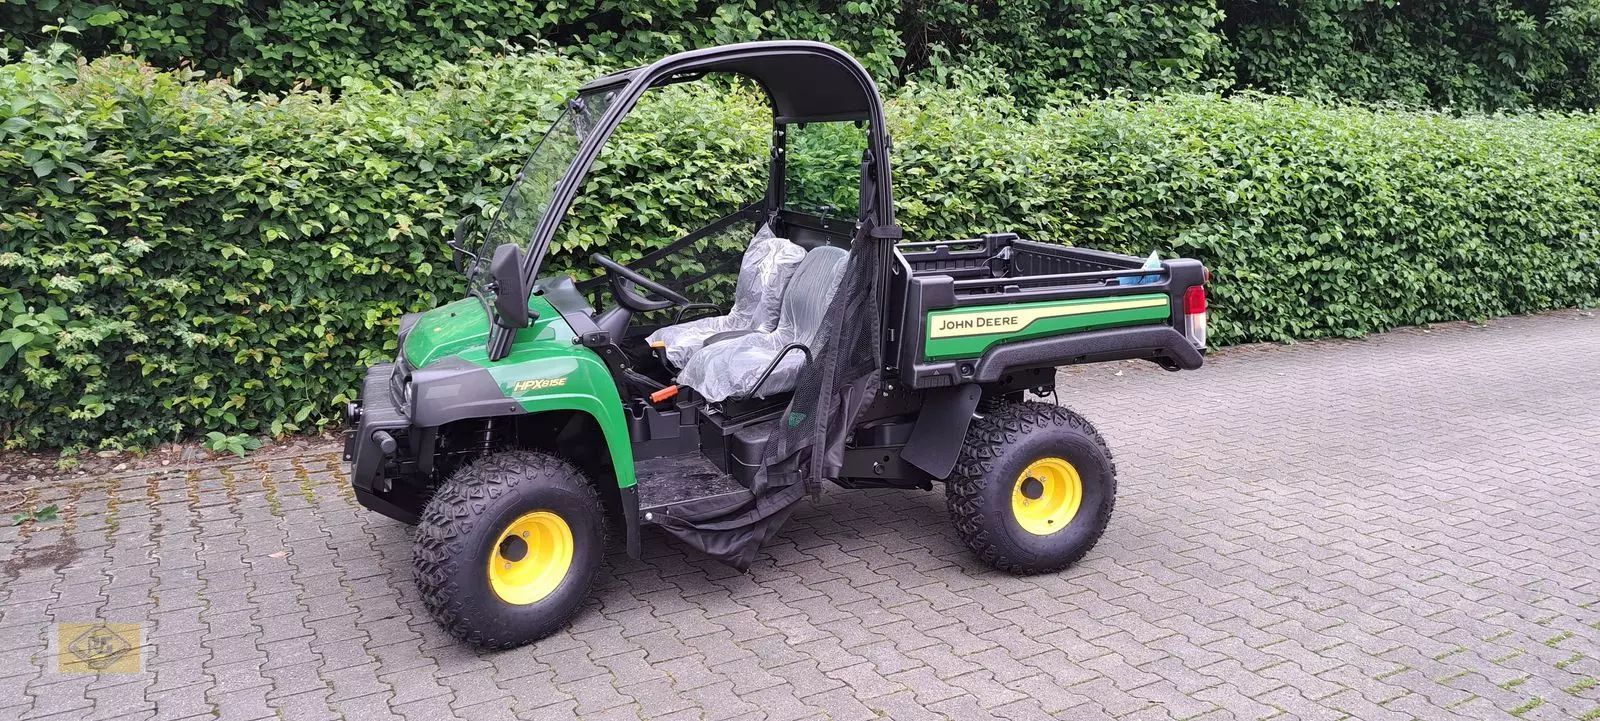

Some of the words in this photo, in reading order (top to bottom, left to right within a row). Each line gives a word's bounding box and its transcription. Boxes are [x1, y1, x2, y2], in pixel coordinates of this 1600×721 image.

[939, 319, 973, 331] JOHN
[976, 316, 1018, 328] DEERE
[513, 377, 567, 391] HPX815E
